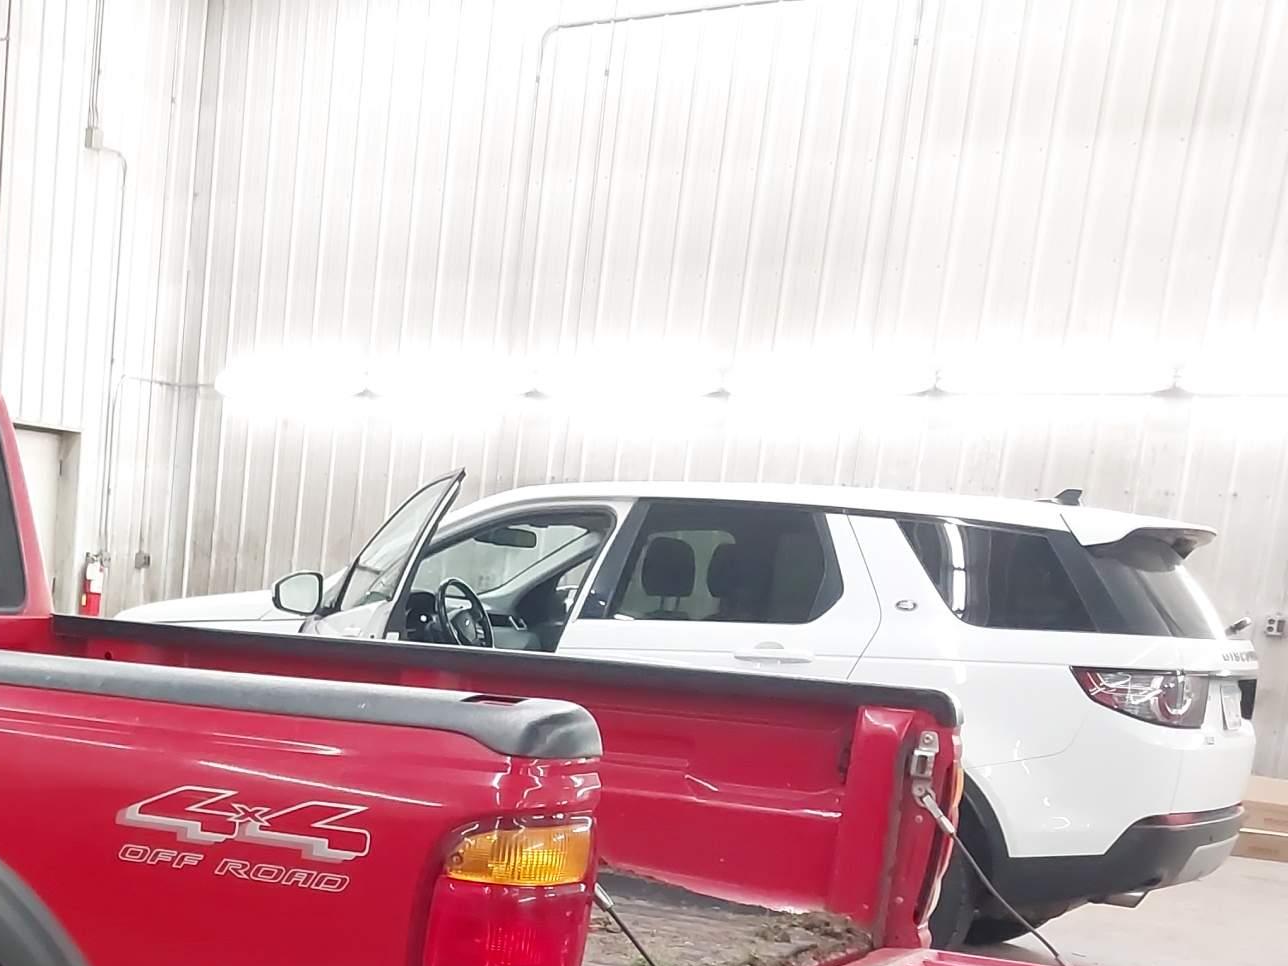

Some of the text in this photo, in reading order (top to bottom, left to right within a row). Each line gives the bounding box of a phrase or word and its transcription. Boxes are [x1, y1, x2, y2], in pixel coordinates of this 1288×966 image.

[116, 785, 372, 863] 4x4
[118, 844, 351, 893] OFF ROAD
